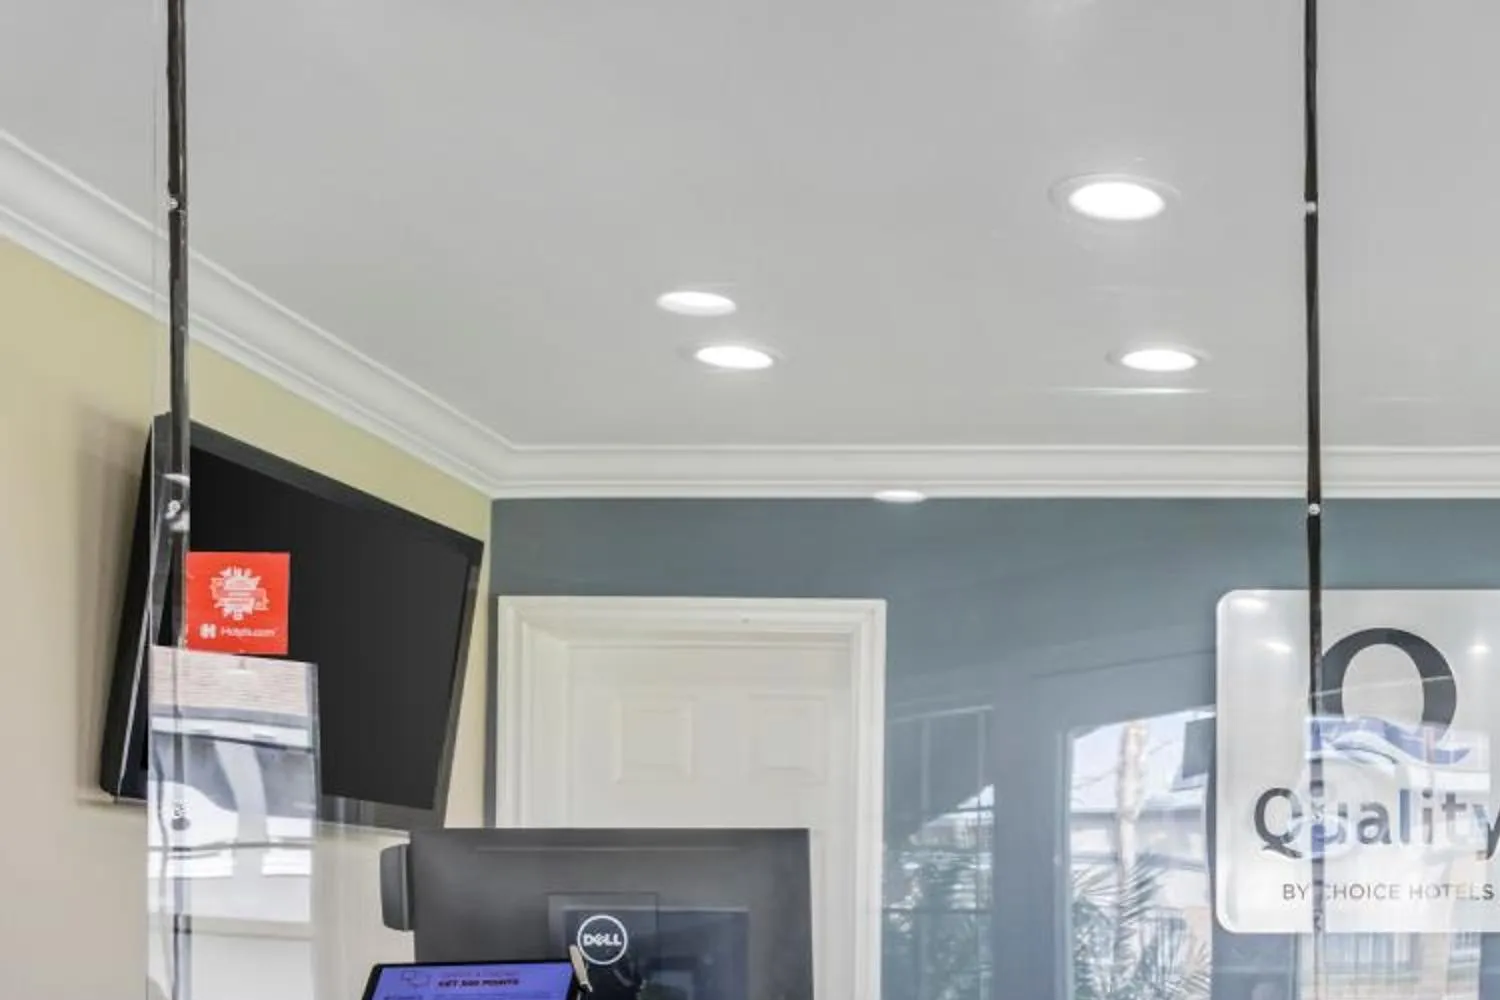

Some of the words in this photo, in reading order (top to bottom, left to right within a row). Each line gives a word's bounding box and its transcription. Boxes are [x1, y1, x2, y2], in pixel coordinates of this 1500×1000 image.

[1283, 884, 1308, 900] BY
[1323, 884, 1401, 901] CHOICE
[1409, 884, 1495, 901] HOTELS
[583, 933, 622, 947] DELL
